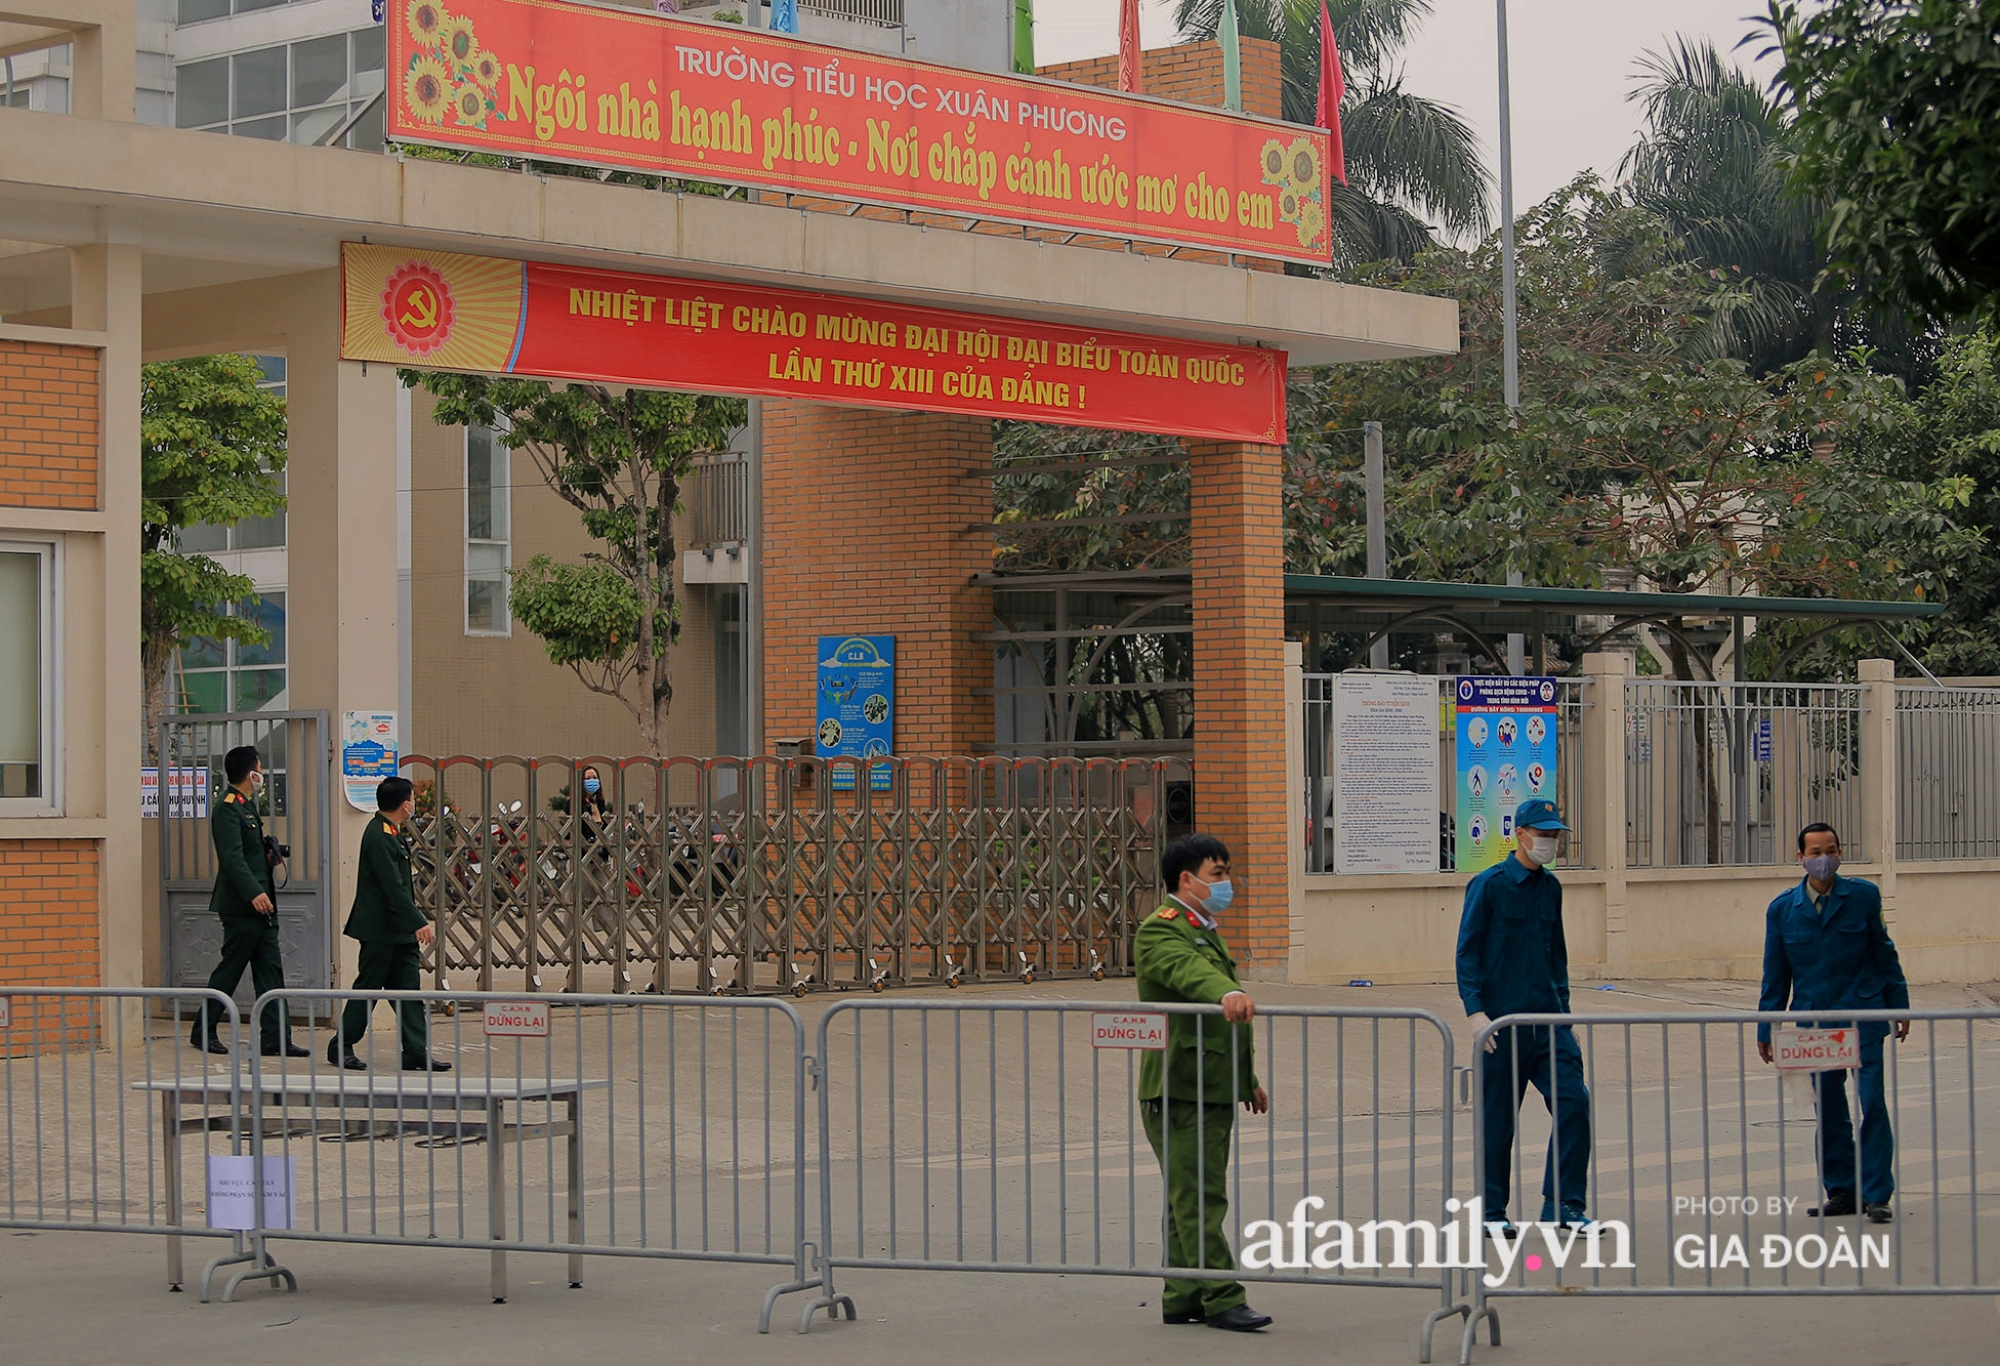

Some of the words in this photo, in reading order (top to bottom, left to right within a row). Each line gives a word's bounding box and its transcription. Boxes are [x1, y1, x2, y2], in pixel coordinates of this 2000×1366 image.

[675, 46, 795, 88] TRƯỜNG
[803, 57, 855, 98] TIỂU
[864, 80, 927, 111] HỌC
[936, 87, 1009, 123] XUÂN
[1018, 105, 1127, 141] PHƯƠNG
[506, 63, 587, 140] Ngôi
[597, 78, 660, 142] nhà
[670, 90, 752, 160] hạnh
[762, 107, 840, 170] phúc
[848, 141, 858, 156] -
[865, 118, 919, 179] Nơi
[927, 121, 997, 200] chắp
[1005, 140, 1071, 200] cánh
[1079, 153, 1129, 208] ước
[1136, 172, 1177, 214] mơ
[1184, 171, 1230, 223] cho
[1236, 190, 1274, 230] em
[569, 287, 657, 326] NHIỆT
[664, 296, 723, 333] LIỆT
[732, 304, 807, 338] CHÀO
[815, 313, 897, 348] MỪNG
[905, 325, 949, 358] ĐẠI
[957, 329, 999, 363] HỘI
[1006, 337, 1048, 370] ĐẠI
[1056, 336, 1111, 371] BIỂU
[1119, 347, 1179, 379] TOÀN
[1186, 354, 1245, 387] QUỐC
[768, 346, 822, 383] LẦN
[831, 358, 885, 389] THỨ
[889, 366, 934, 394] XIII
[942, 365, 994, 400] CỦA
[1000, 371, 1070, 408] ĐẢNG
[1078, 386, 1086, 409] !
[524, 1016, 544, 1029] LẠI
[1139, 1029, 1162, 1042] LẠI
[1827, 1046, 1852, 1059] LẠI
